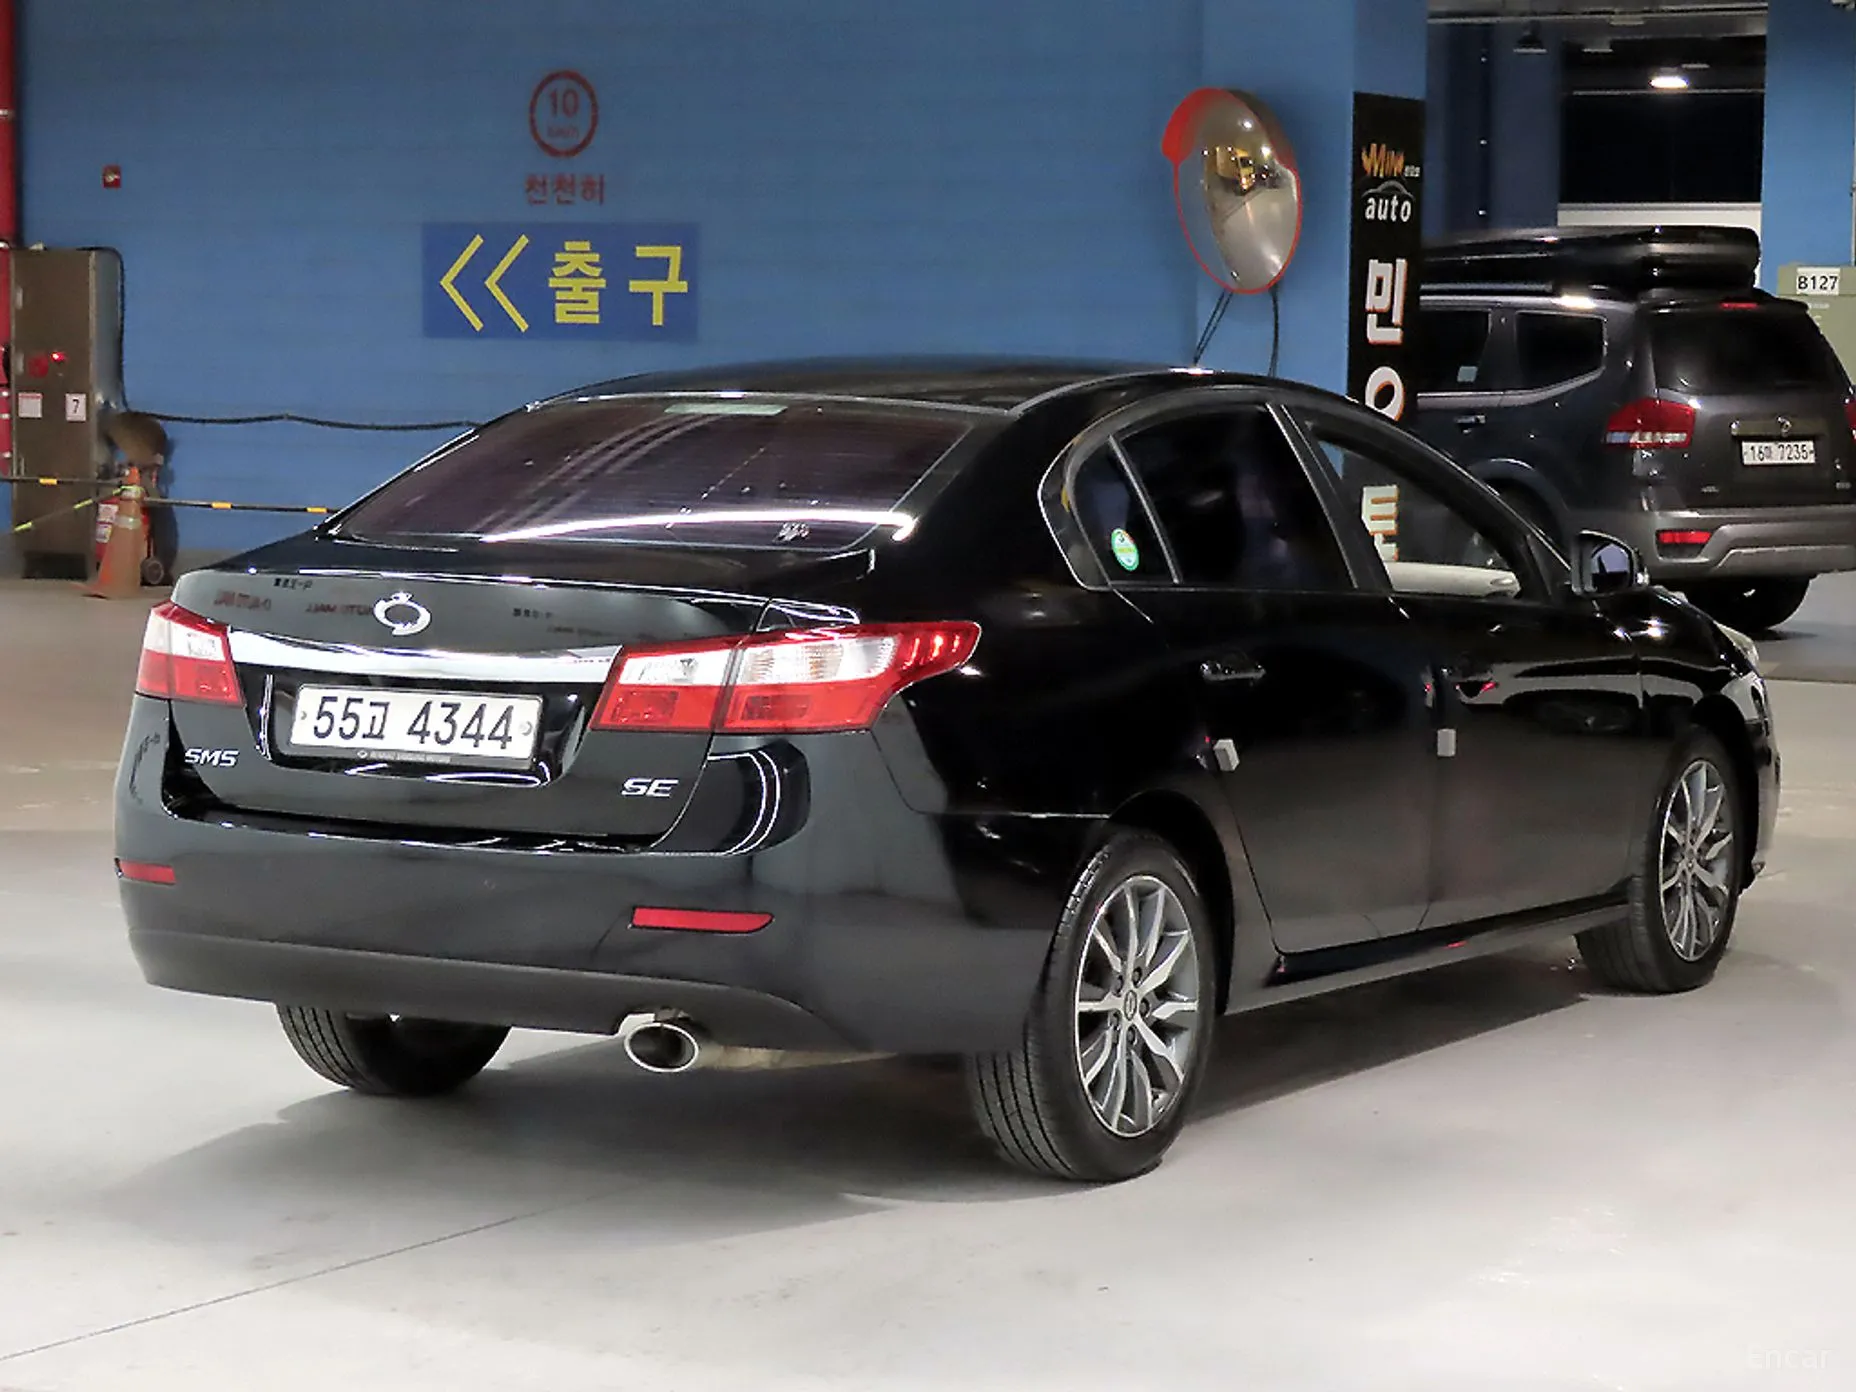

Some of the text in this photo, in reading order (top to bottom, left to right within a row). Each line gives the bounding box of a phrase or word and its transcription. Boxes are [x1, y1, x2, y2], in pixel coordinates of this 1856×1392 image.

[549, 88, 580, 118] 10
[525, 173, 605, 206] 천천히
[1364, 194, 1412, 222] auto
[548, 240, 688, 326] 출구
[1797, 275, 1838, 290] B127
[72, 398, 80, 414] 7
[1777, 443, 1809, 461] 7235
[313, 696, 514, 749] 55고 4344
[621, 777, 679, 798] SE
